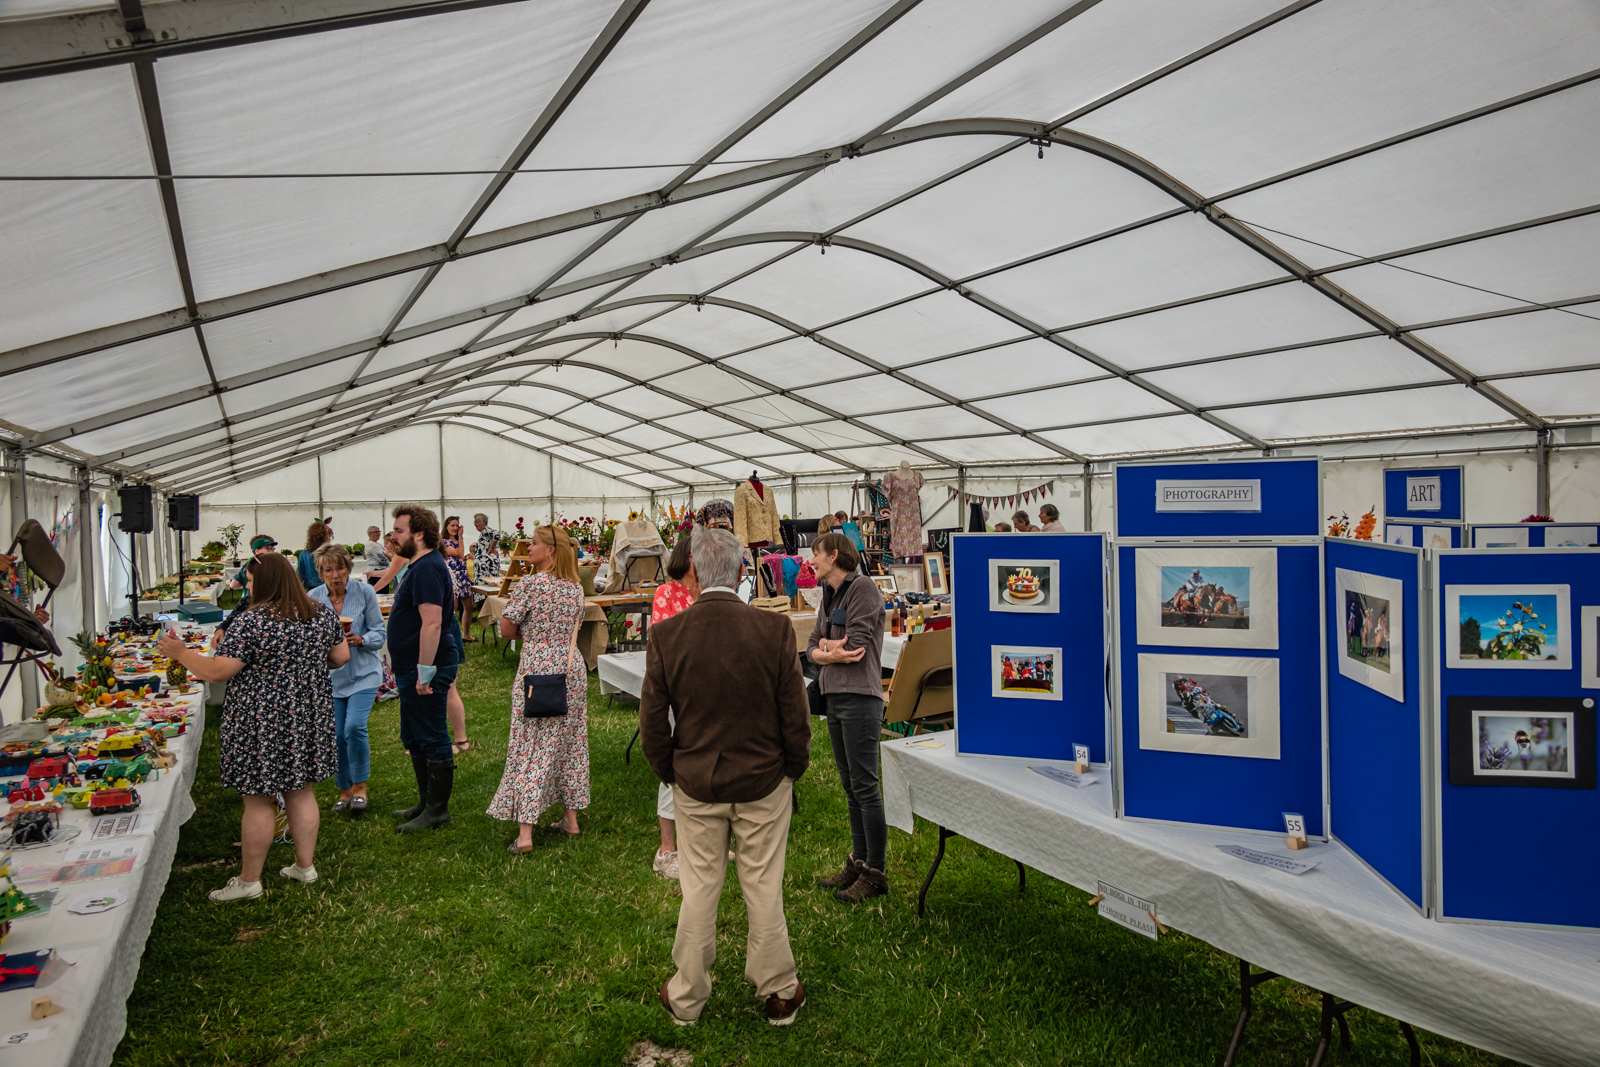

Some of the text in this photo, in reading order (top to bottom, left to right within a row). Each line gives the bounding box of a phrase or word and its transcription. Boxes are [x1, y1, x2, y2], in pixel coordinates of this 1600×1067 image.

[1165, 489, 1250, 500] PHOTOGRAPHY
[1409, 484, 1436, 502] ART
[1015, 567, 1032, 578] 70
[1076, 749, 1087, 760] 54
[1287, 819, 1302, 832] 55
[1249, 852, 1309, 868] ADVENTUROUS
[1267, 860, 1299, 871] EVENT
[1099, 883, 1152, 912] NO DOGS IN THE
[1099, 903, 1155, 934] MARQUEE PLEASE
[7, 1032, 29, 1044] 48
